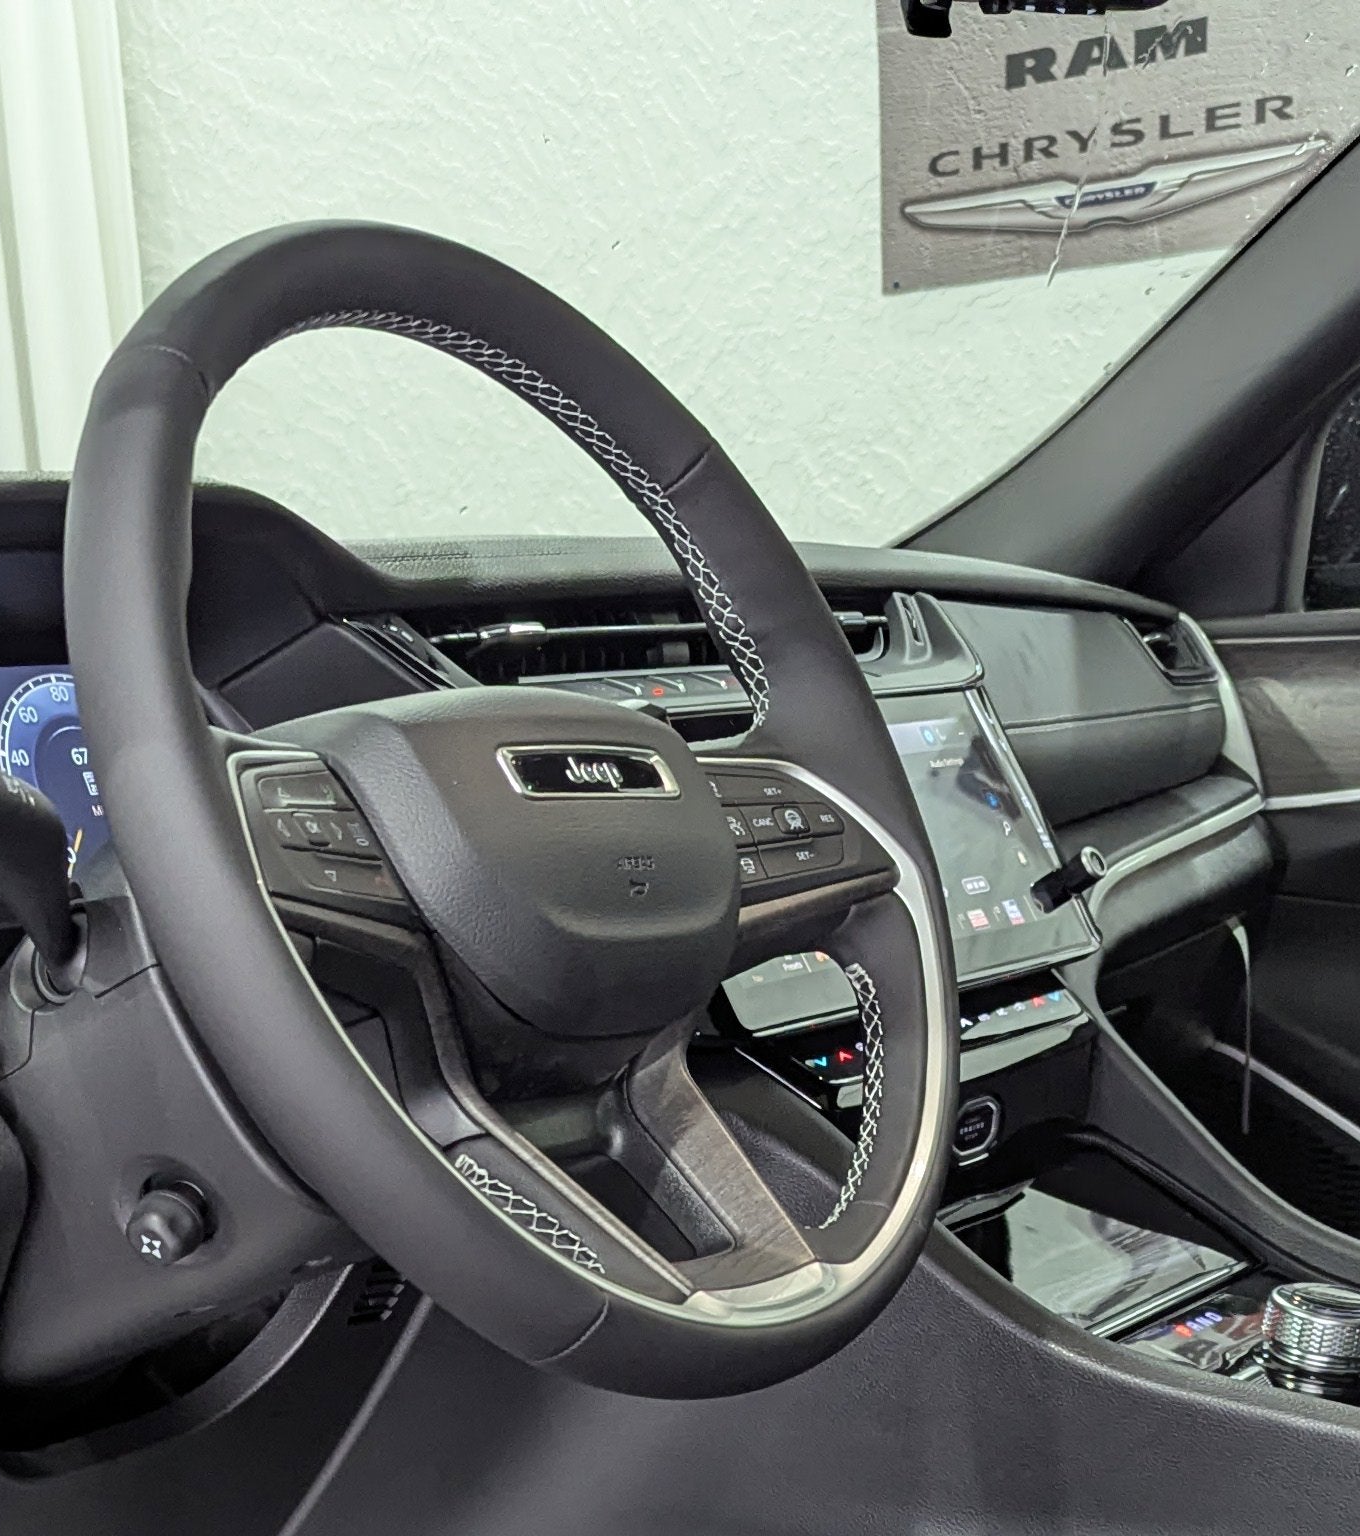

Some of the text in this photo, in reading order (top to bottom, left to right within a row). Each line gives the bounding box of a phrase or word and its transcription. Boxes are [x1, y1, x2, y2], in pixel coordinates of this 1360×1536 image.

[1004, 16, 1208, 90] RAM
[927, 94, 1296, 178] CHRYSLER
[1065, 186, 1146, 205] CRYSLER
[49, 686, 69, 702] 80
[18, 706, 39, 723] 60
[11, 749, 30, 767] 40
[565, 756, 623, 789] Jeep
[819, 814, 835, 824] RES
